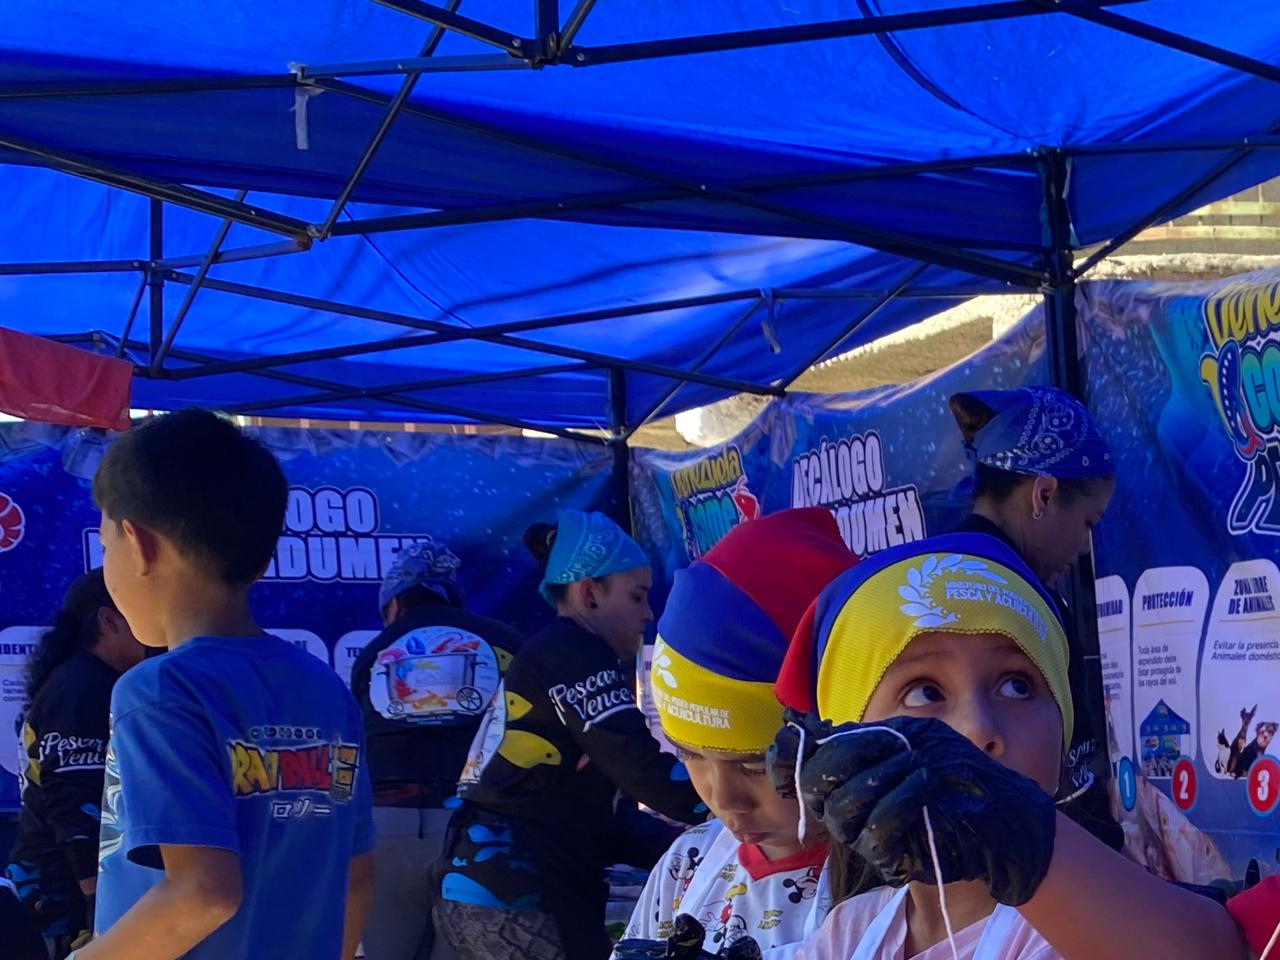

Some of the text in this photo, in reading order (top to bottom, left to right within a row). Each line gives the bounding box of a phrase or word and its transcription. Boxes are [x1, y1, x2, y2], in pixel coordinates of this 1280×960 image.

[945, 588, 982, 602] PESCA
[984, 590, 993, 602] Y
[1141, 588, 1194, 611] PROTECCIÓN
[1211, 651, 1247, 662] Animales
[1213, 640, 1236, 651] Evitar
[1237, 640, 1245, 651] la
[1246, 639, 1279, 652] presencia
[573, 686, 636, 721] Vence
[1122, 768, 1132, 793] 1
[1178, 769, 1189, 800] 2
[1256, 770, 1270, 801] 3
